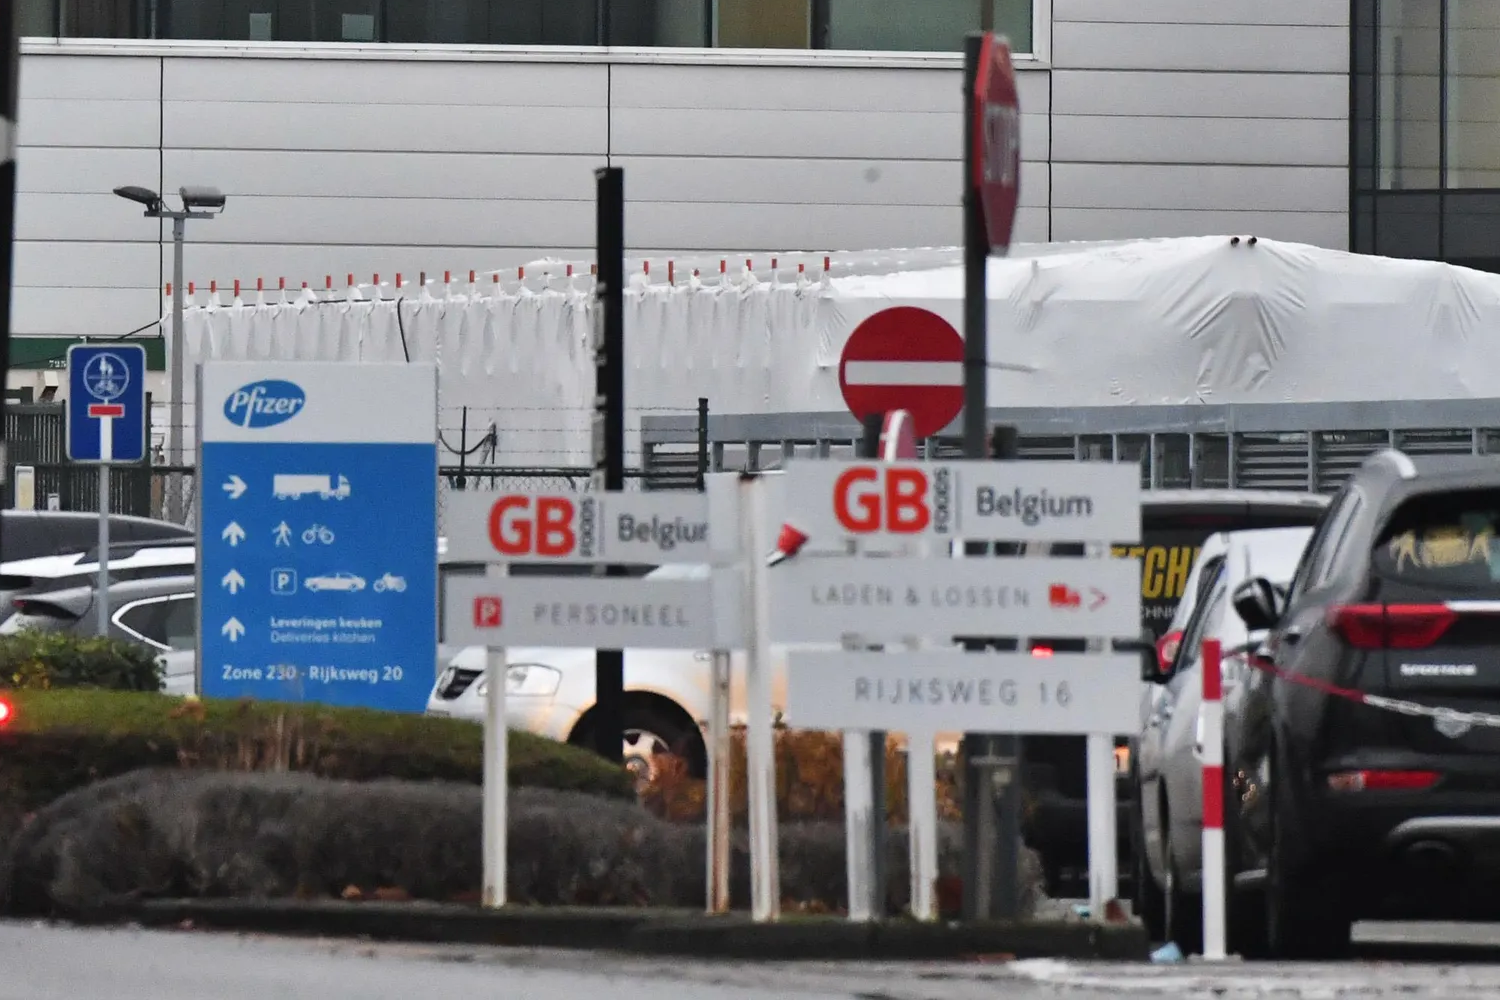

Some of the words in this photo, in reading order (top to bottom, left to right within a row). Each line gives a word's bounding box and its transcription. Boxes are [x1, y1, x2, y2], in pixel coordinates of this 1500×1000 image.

[229, 385, 303, 428] Pfizer
[833, 466, 931, 534] GB
[975, 486, 1094, 527] Belgium
[487, 494, 577, 557] GB
[811, 584, 893, 605] LADEN
[905, 587, 919, 606] &
[931, 586, 1031, 608] LOSSEN
[270, 616, 336, 631] Leveringen
[339, 616, 383, 629] keuken
[533, 602, 691, 628] PERSONEEL
[270, 631, 330, 643] Deliveries
[332, 631, 376, 643] kitchen
[222, 665, 263, 681] Zone
[308, 665, 379, 684] Rijksweg
[382, 665, 404, 681] 20
[854, 677, 1020, 707] RIJKSWEG
[1039, 681, 1073, 708] 16
